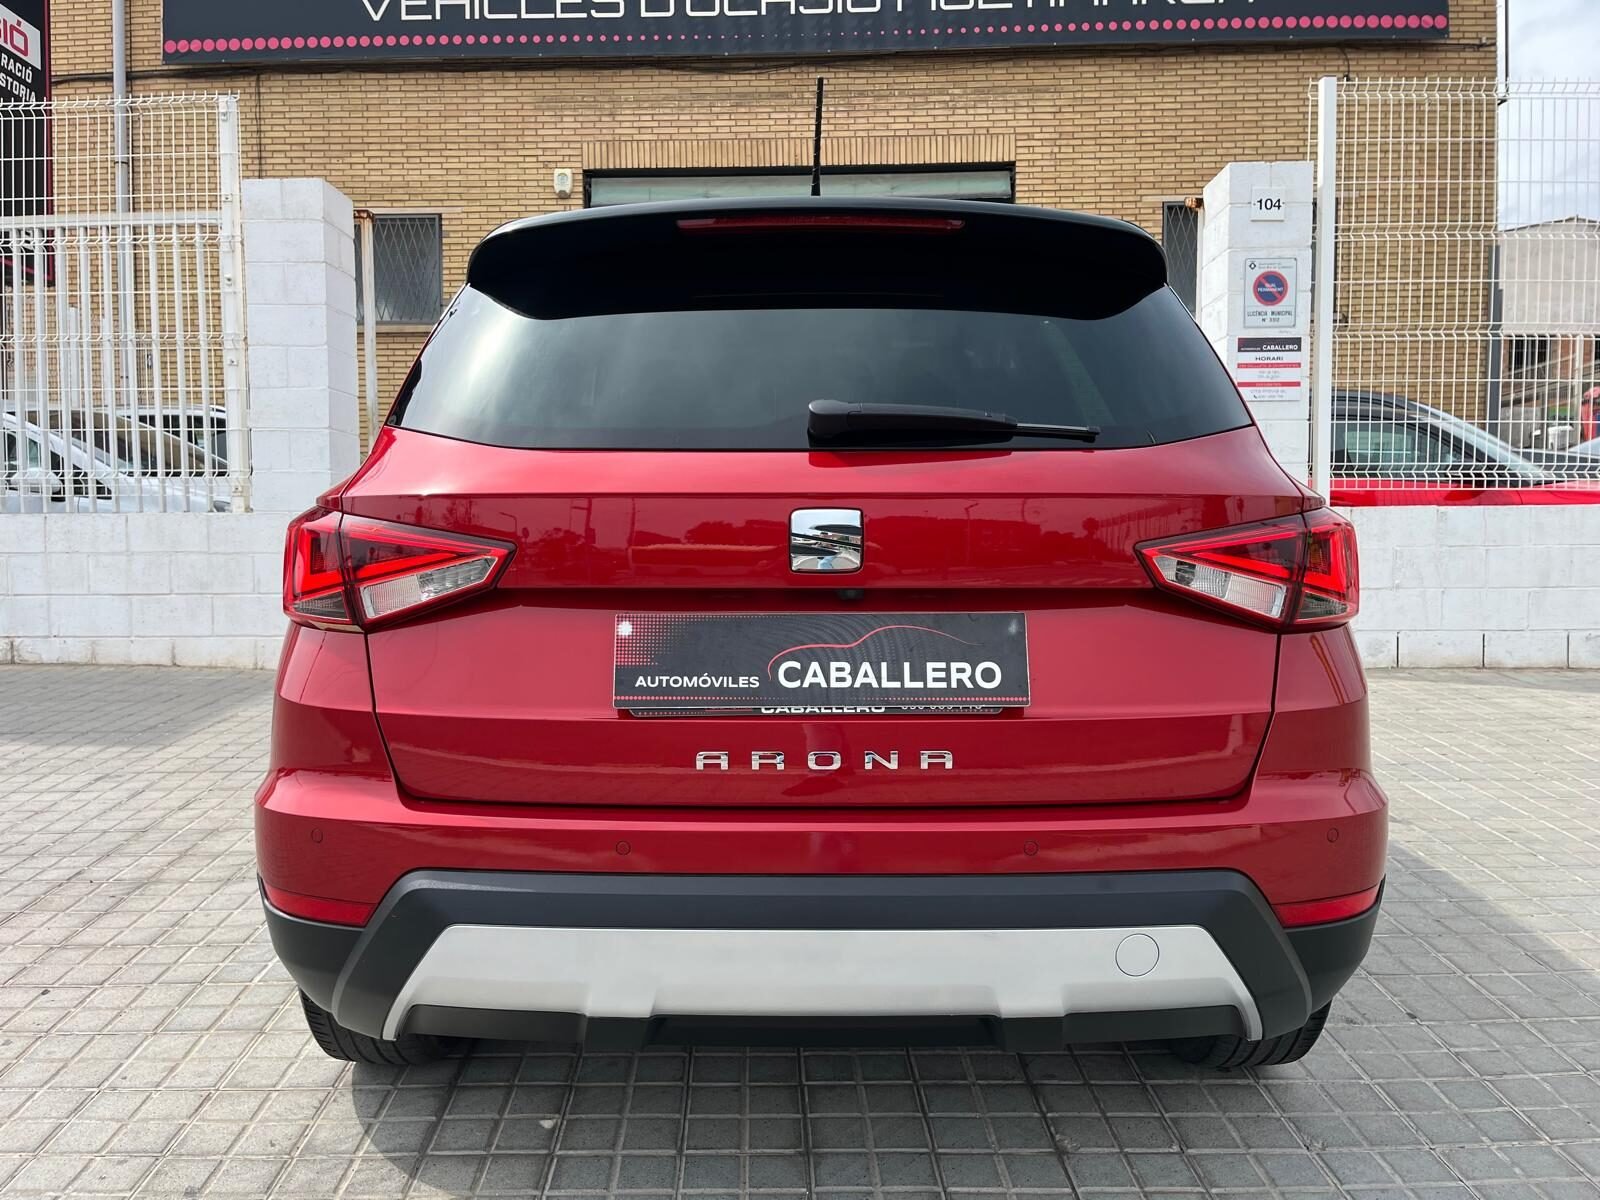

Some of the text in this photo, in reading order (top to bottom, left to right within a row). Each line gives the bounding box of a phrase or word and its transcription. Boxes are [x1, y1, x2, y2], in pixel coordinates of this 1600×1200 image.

[1256, 198, 1282, 210] 104
[634, 660, 1002, 689] AUTOMÓVILES CABALLERO
[695, 750, 954, 771] ARONA
